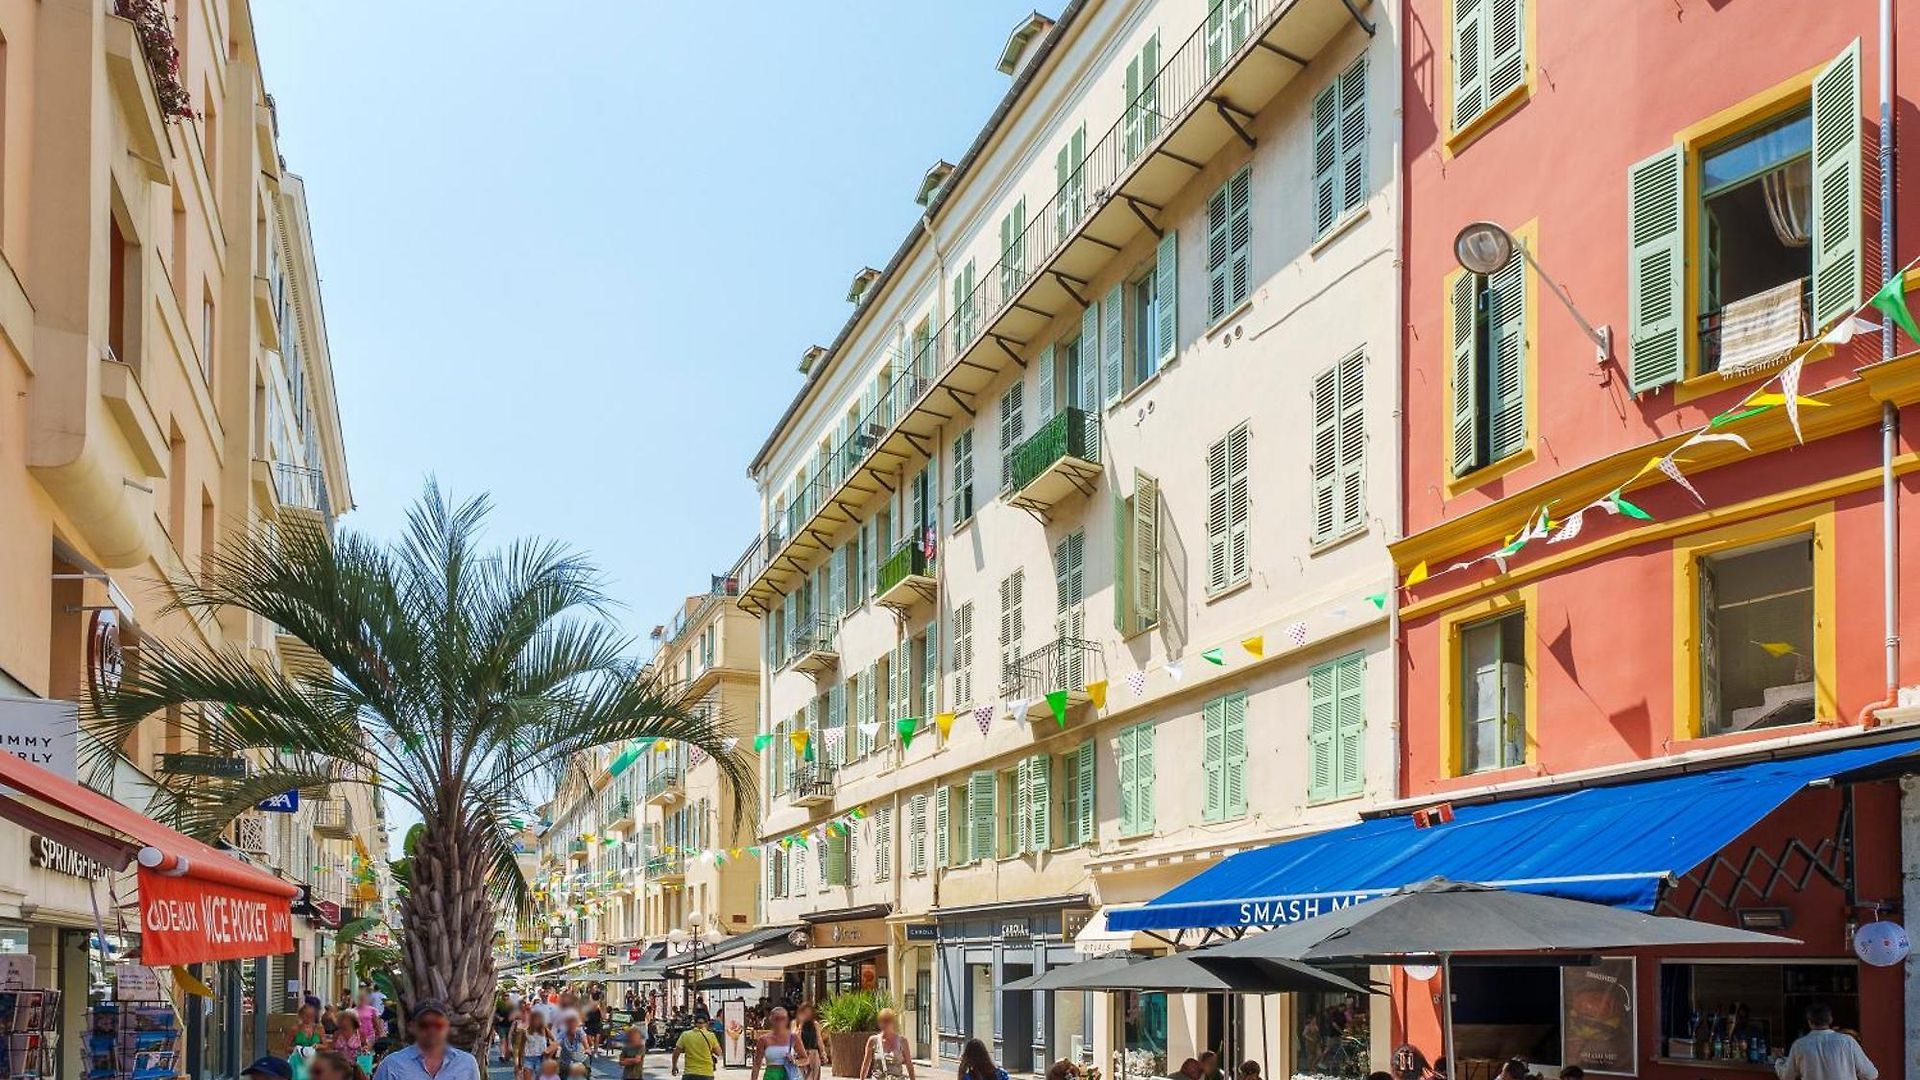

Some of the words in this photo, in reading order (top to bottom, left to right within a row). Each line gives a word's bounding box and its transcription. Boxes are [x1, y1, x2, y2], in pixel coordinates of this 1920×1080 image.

[0, 735, 52, 748] IMMY
[10, 751, 53, 764] RLY
[1240, 899, 1319, 923] SMASH
